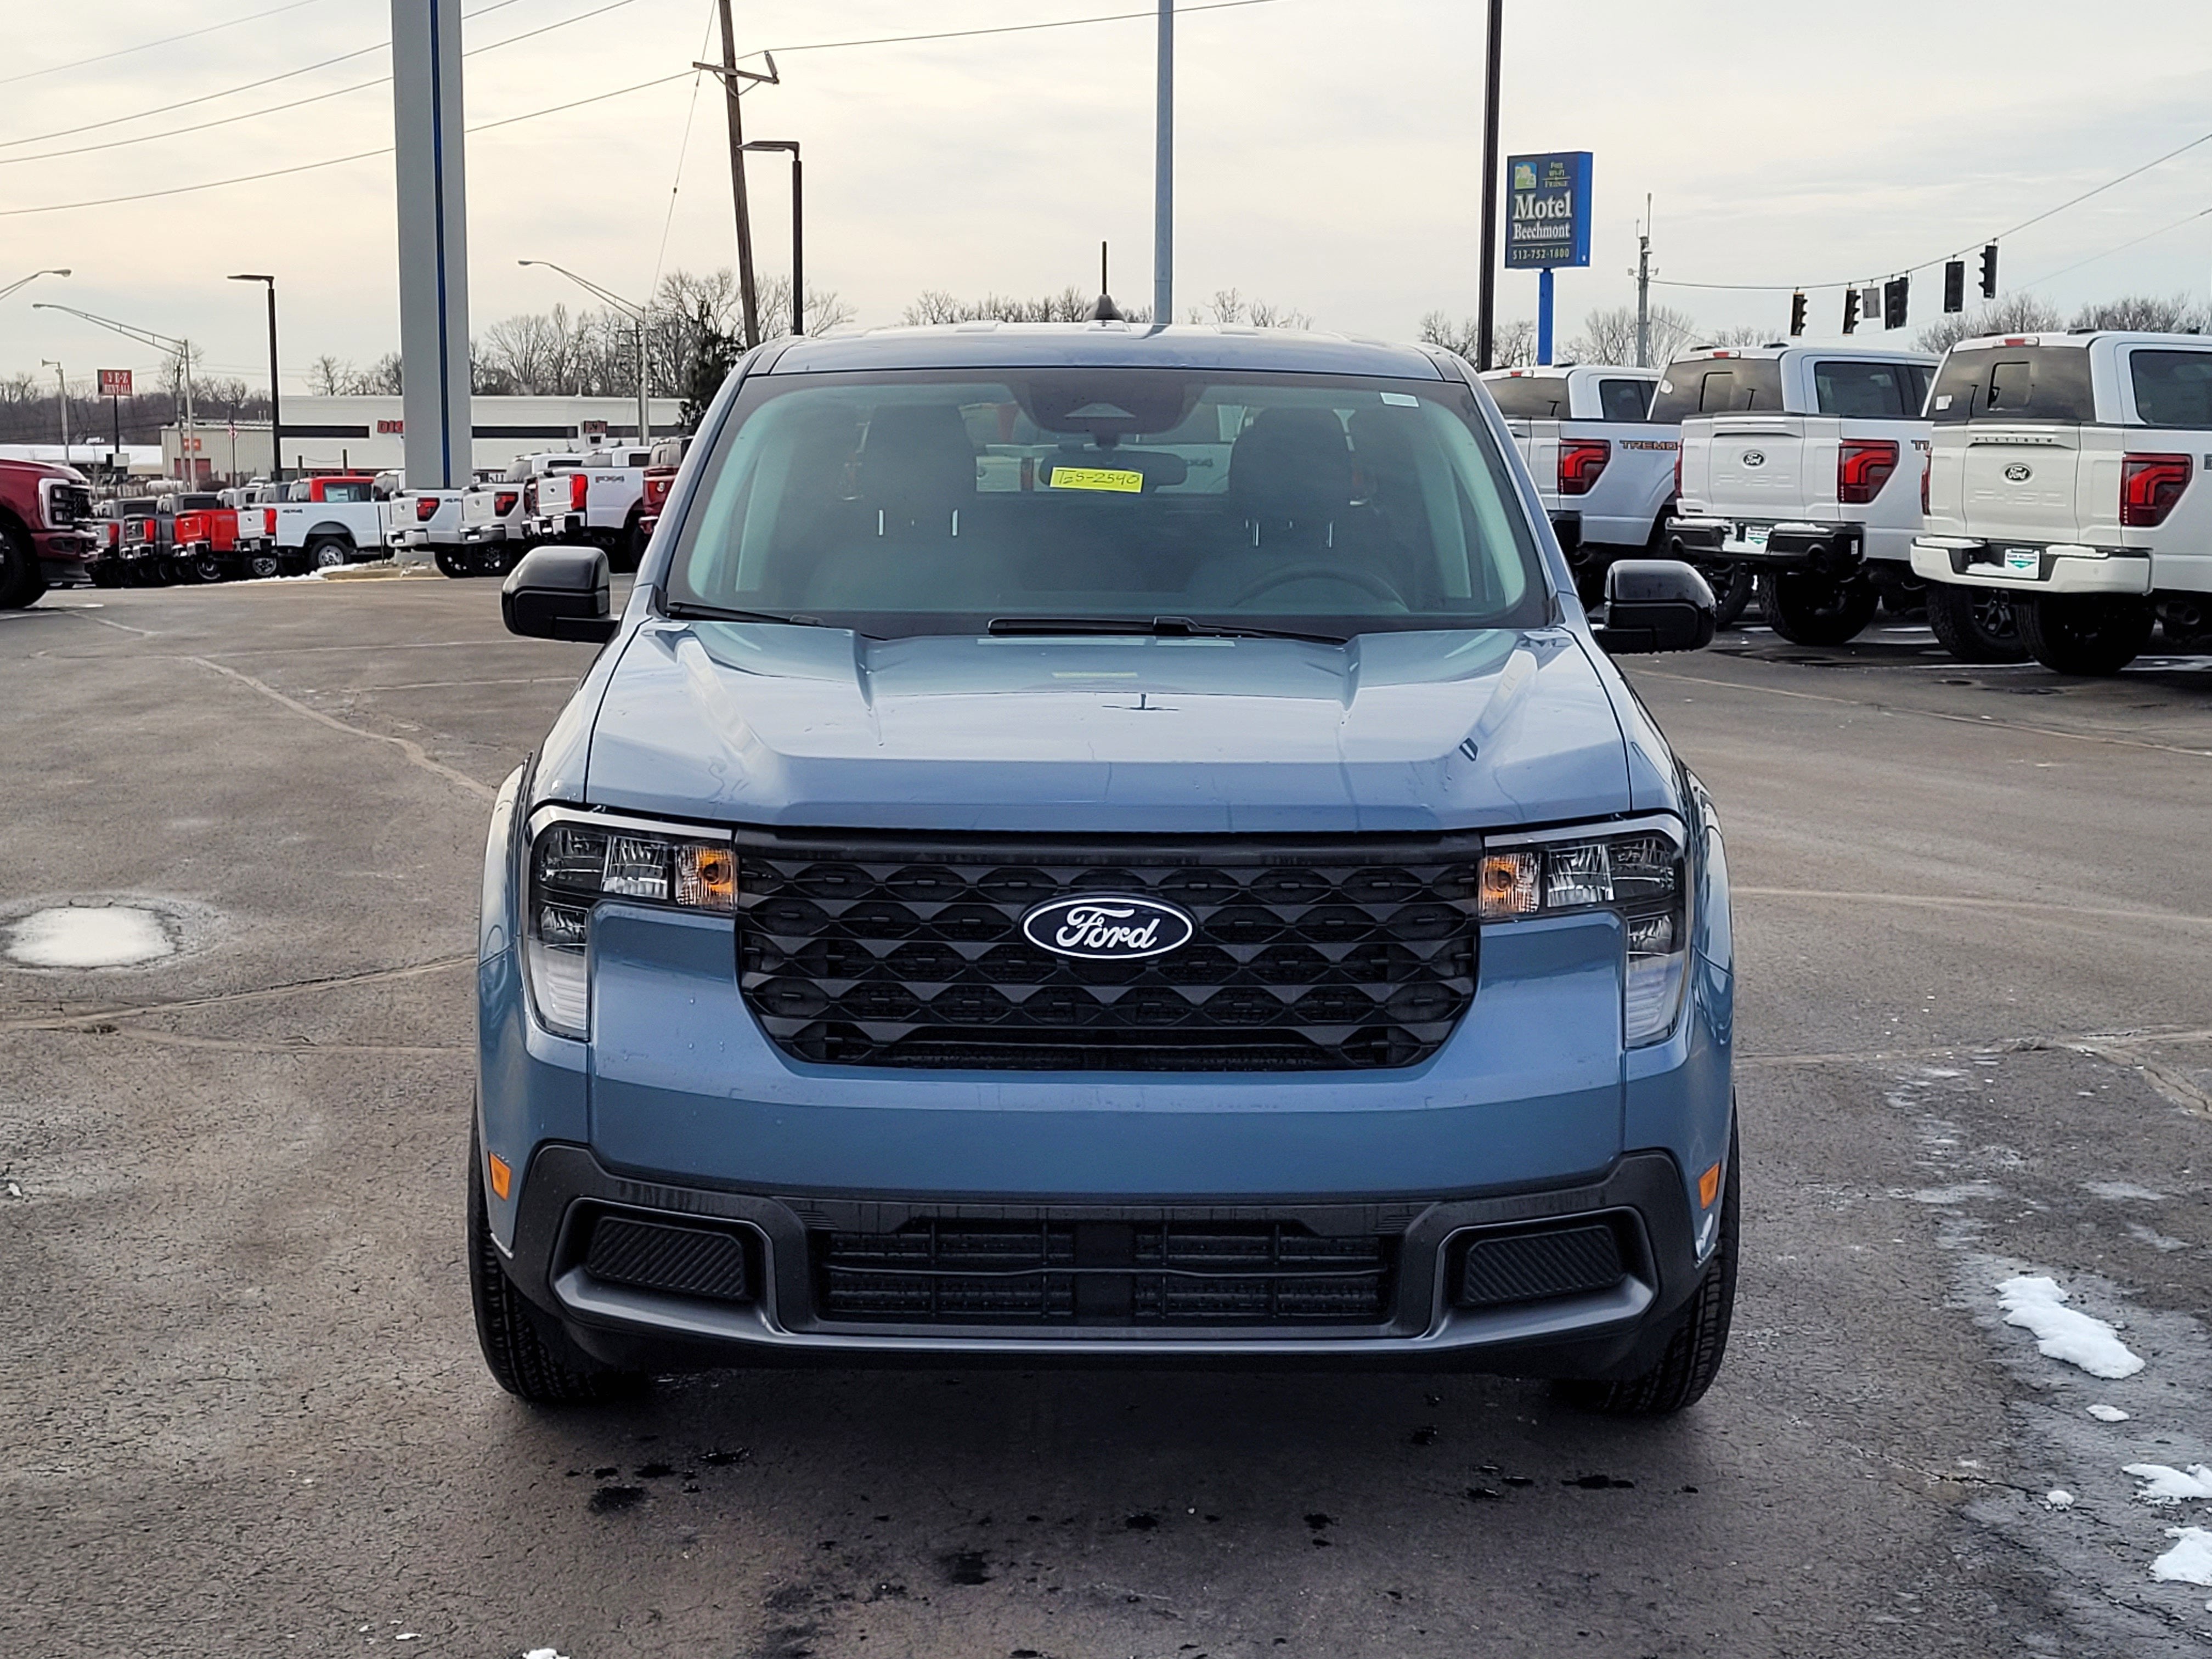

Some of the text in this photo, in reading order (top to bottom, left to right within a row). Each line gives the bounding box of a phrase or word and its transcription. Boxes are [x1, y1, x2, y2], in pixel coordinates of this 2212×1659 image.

[1512, 190, 1573, 220] Motel
[1513, 221, 1571, 240] Beechmont
[1513, 248, 1570, 261] 513-752-1800
[1619, 440, 1679, 450] TREMO
[1056, 906, 1161, 948] Ford
